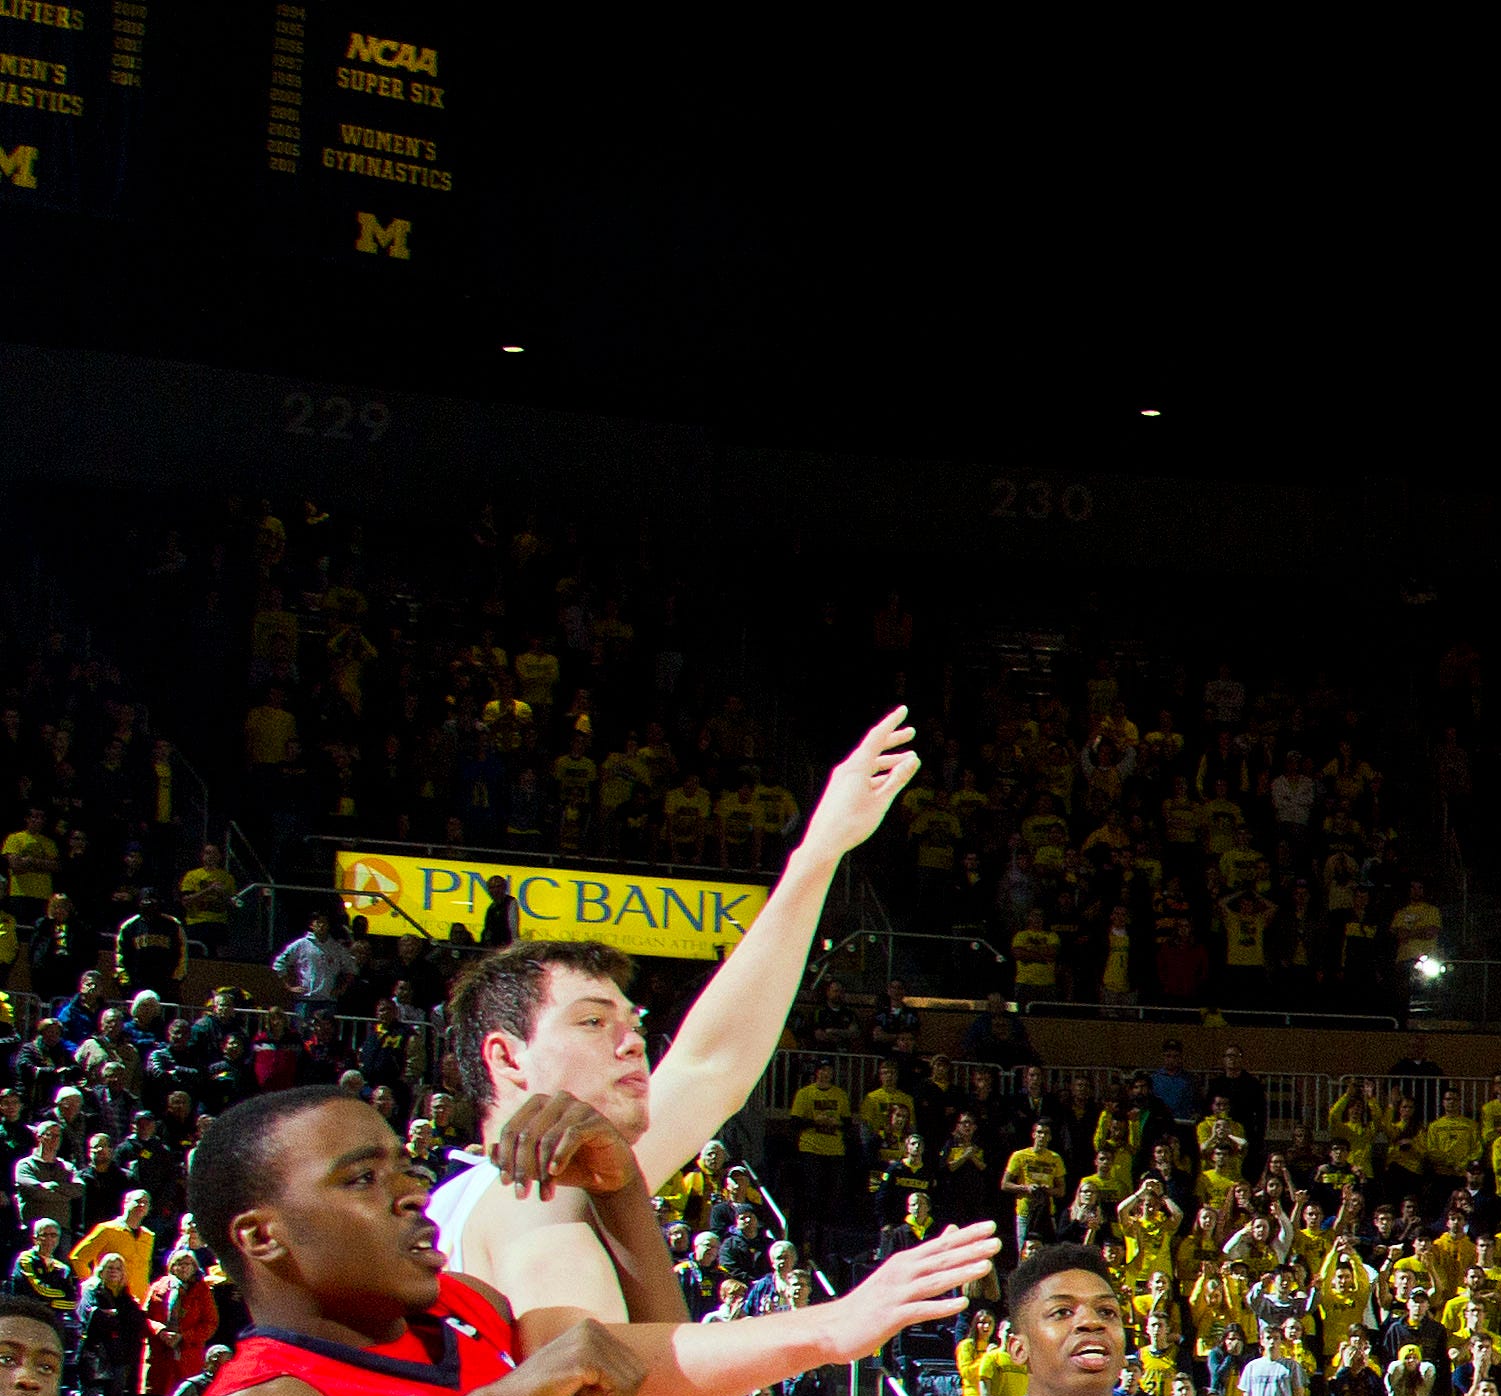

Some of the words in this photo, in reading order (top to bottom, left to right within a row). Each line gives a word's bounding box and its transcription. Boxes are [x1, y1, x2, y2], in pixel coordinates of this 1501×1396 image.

[345, 32, 439, 77] NCAA
[336, 67, 405, 101] SUPER
[409, 82, 446, 109] SIX
[340, 123, 437, 161] WOMEN'S
[322, 147, 453, 192] GYMNASTICS
[355, 211, 412, 260] M
[282, 391, 391, 443] 229
[990, 477, 1094, 521] 230
[416, 867, 561, 921] PNC
[565, 879, 751, 935] BANK
